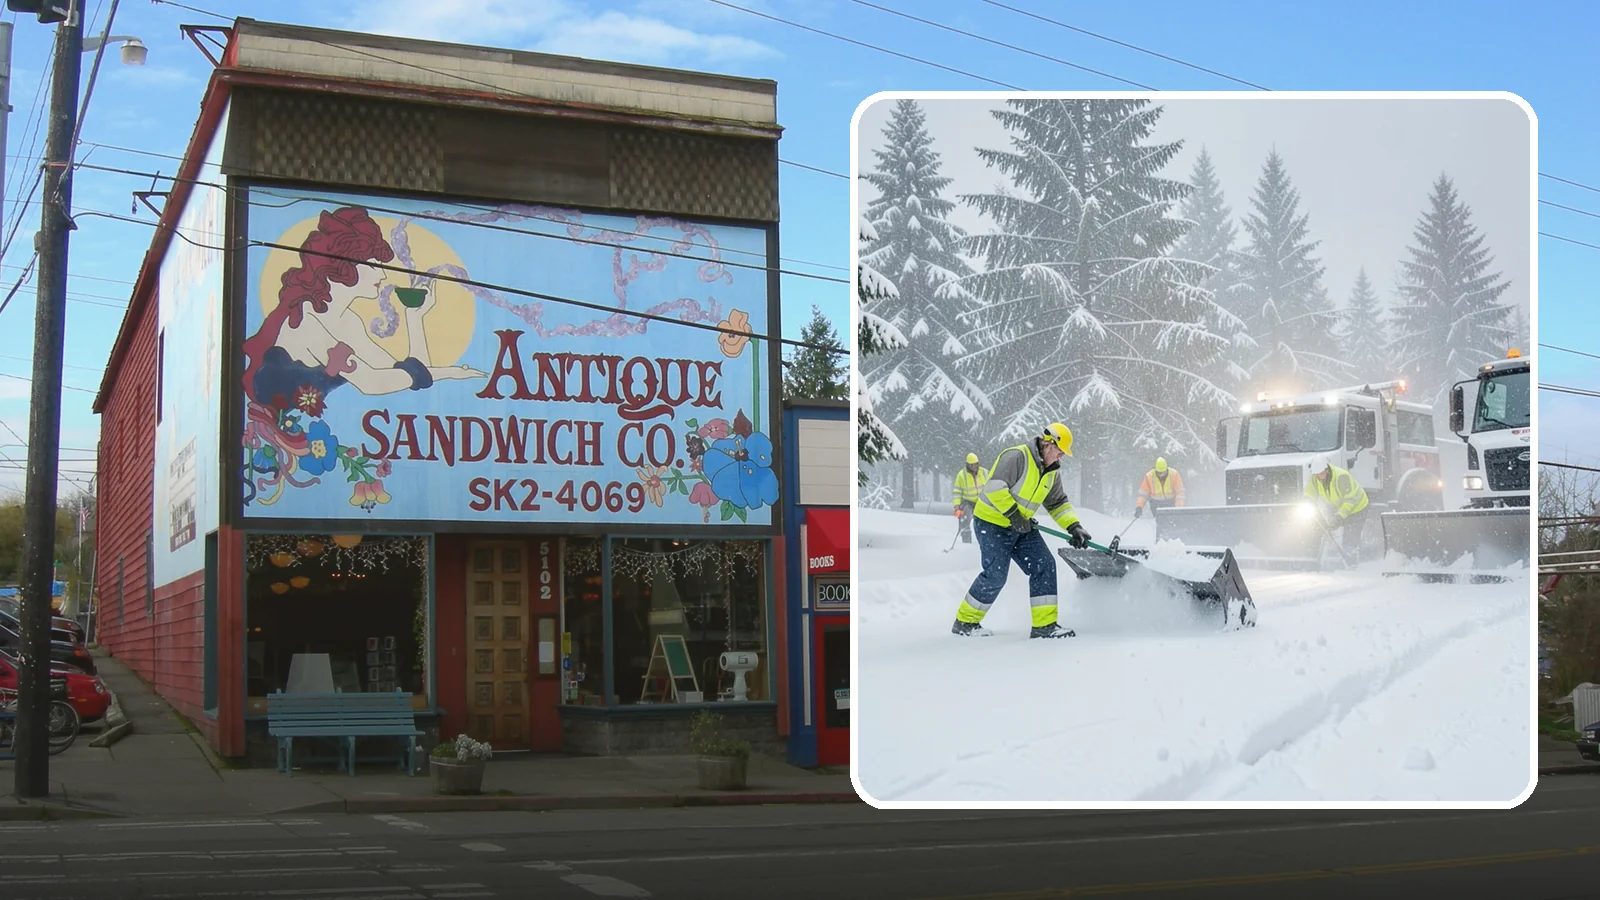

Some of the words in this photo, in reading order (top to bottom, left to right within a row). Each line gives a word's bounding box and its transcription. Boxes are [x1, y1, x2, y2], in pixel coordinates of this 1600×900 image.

[475, 329, 723, 421] ANTIQUE
[361, 409, 605, 466] SANDWICH
[617, 422, 686, 470] CO.
[468, 477, 646, 512] SK2-4069
[540, 541, 551, 600] 5102
[809, 555, 835, 569] BOOKS
